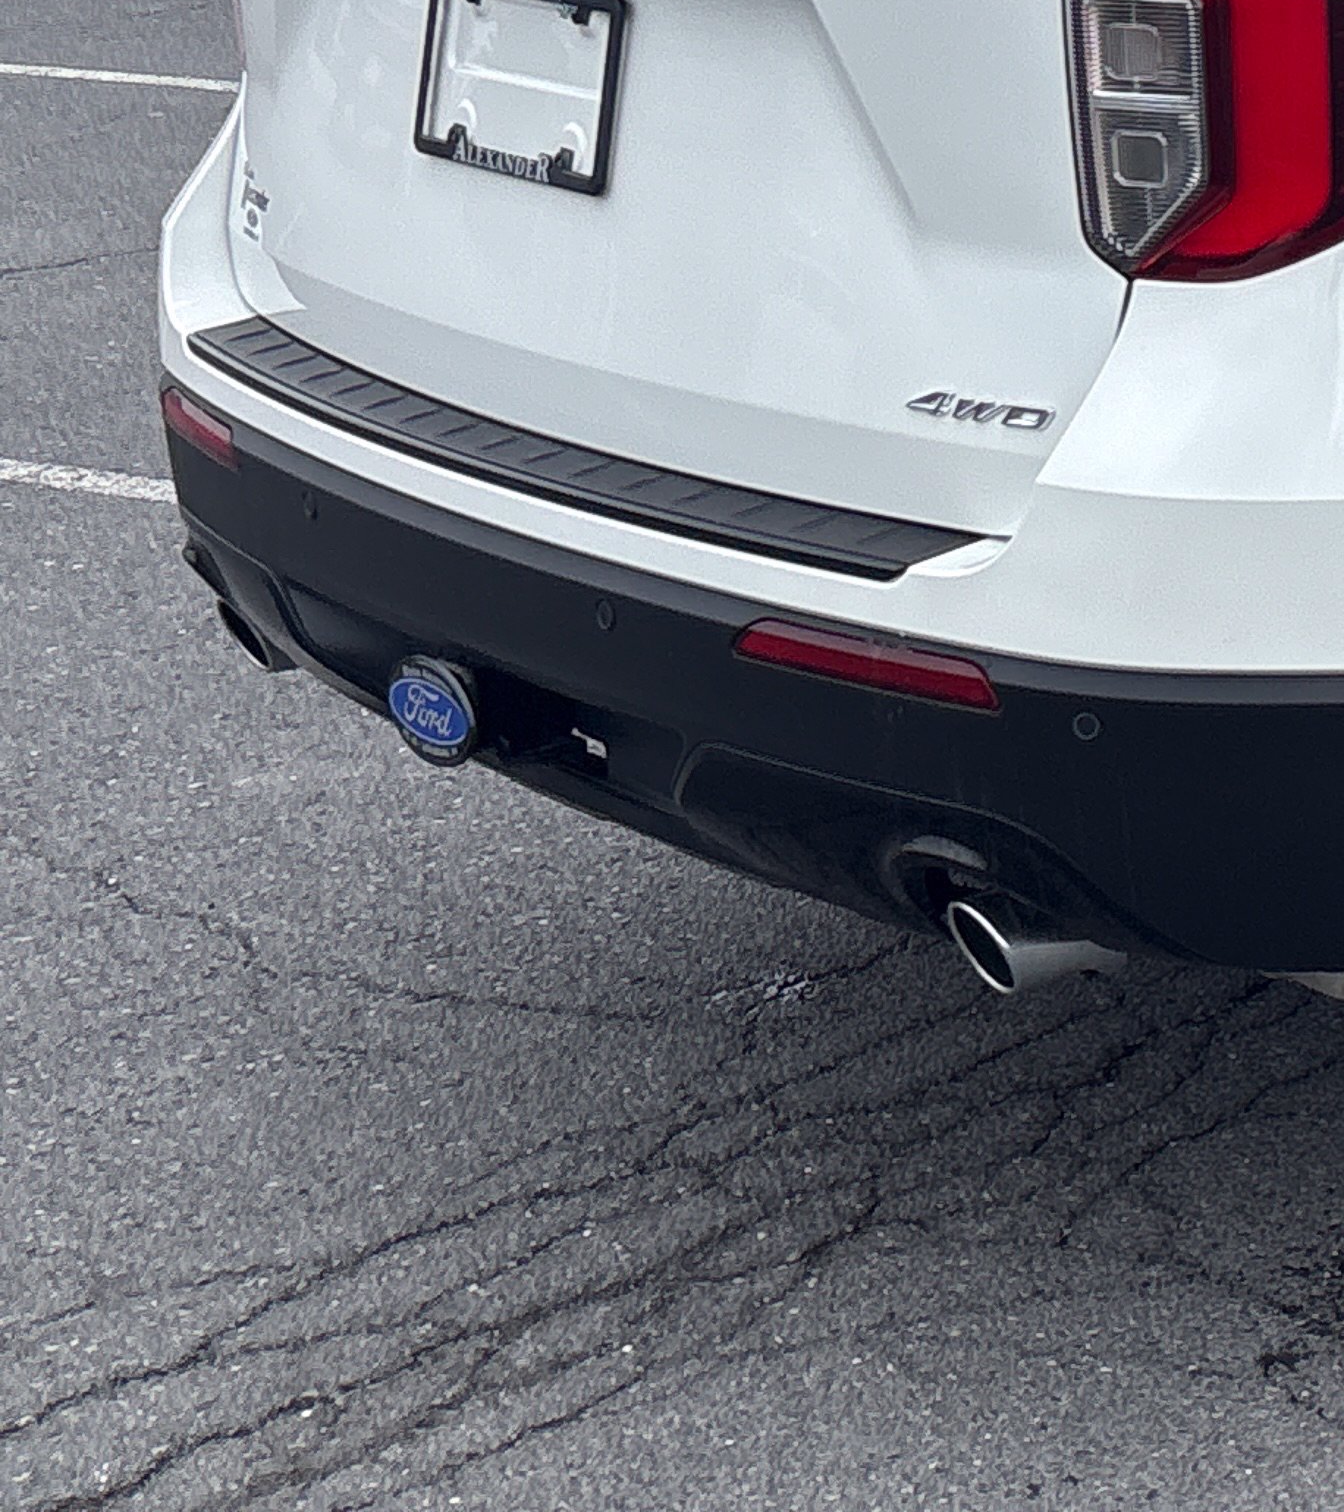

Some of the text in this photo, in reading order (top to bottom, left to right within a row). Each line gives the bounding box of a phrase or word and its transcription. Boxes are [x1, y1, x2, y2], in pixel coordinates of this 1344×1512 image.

[452, 134, 549, 183] ALEXANDER
[905, 391, 1057, 431] 4WD
[404, 684, 453, 737] Ford
